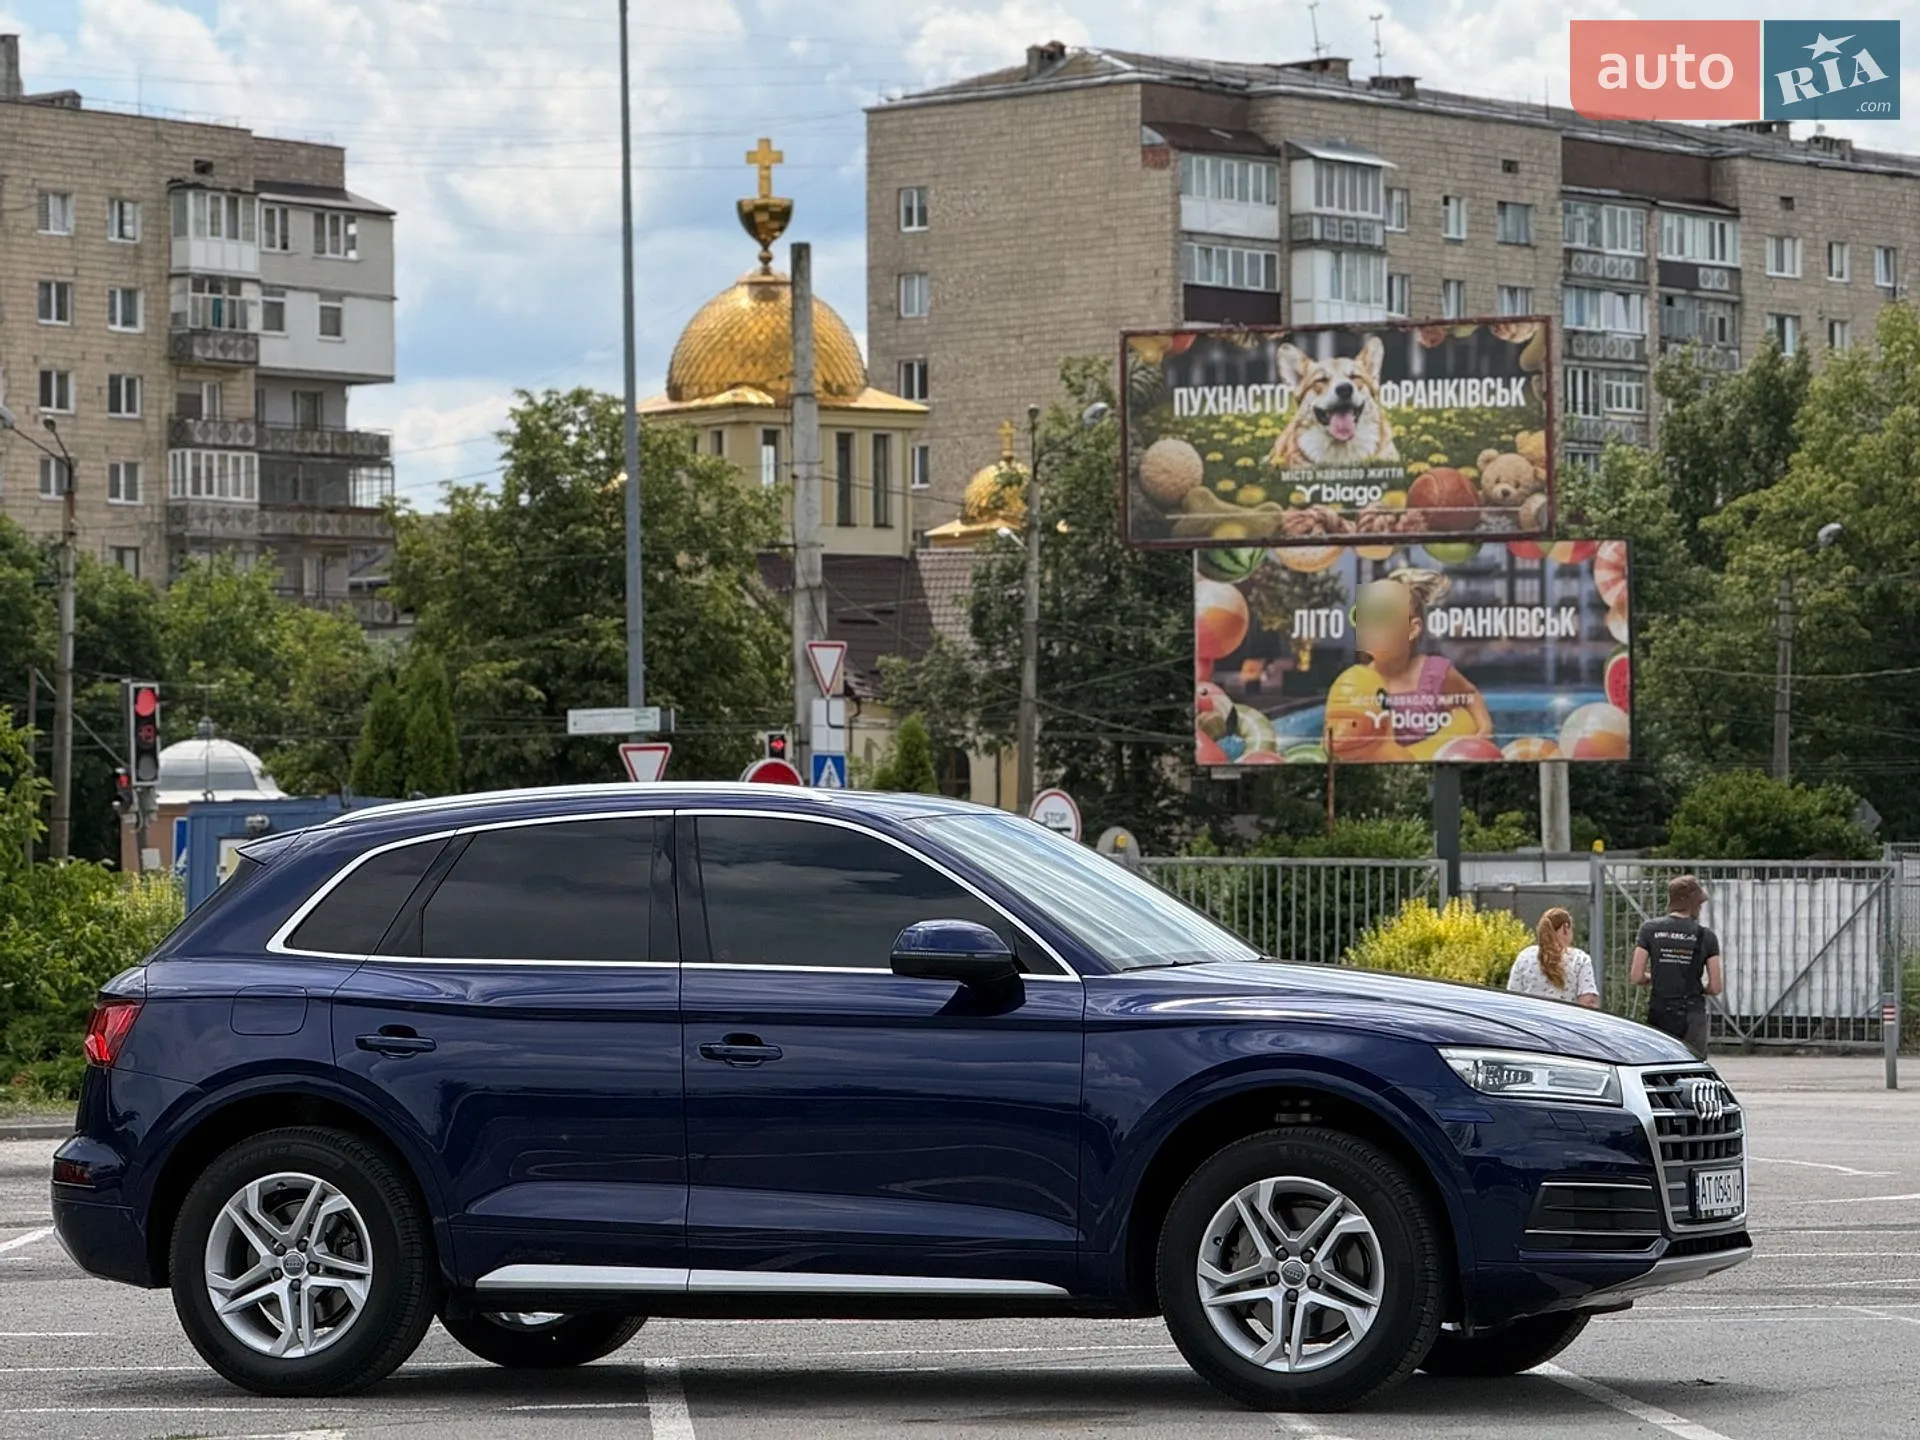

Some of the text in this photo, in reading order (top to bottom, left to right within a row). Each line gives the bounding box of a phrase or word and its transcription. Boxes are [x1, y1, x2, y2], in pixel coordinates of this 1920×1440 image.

[1173, 376, 1526, 417] ПУХНАСТО ФРАНКІВСЬК
[1320, 483, 1382, 507] blago
[1291, 606, 1577, 639] ЛІТО ФРАНКІВСЬК
[1391, 709, 1452, 732] blago
[1701, 1176, 1712, 1205] AT
